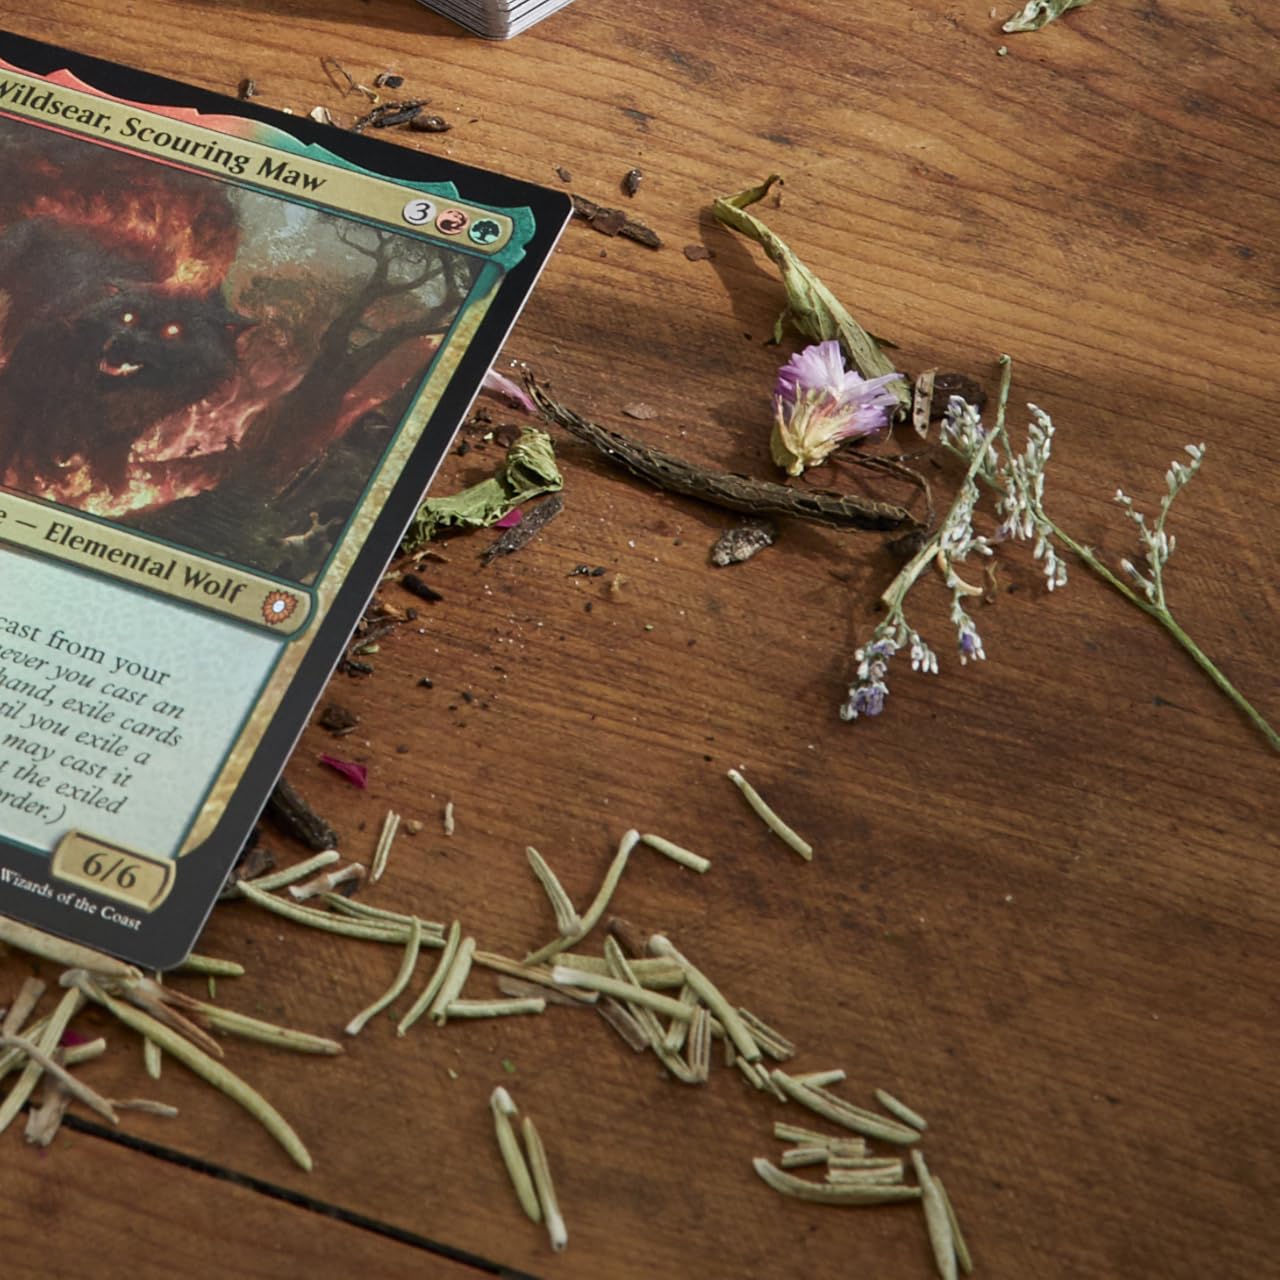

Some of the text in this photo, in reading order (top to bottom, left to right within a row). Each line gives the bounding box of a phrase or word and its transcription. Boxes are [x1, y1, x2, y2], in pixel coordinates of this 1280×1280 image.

[118, 116, 251, 175] Scouring
[255, 155, 328, 192] Maw
[42, 520, 178, 581] Elemental
[182, 565, 248, 604] Wolf
[44, 629, 106, 665] from
[107, 655, 172, 686] your
[44, 664, 96, 689] you
[99, 682, 149, 707] cast
[151, 700, 185, 720] an
[18, 712, 71, 738] you
[73, 730, 129, 758] exile
[132, 751, 152, 766] a
[60, 697, 116, 724] exile
[118, 717, 183, 747] cards
[0, 732, 57, 762] may
[58, 754, 109, 780] cast
[110, 766, 133, 788] it
[11, 763, 51, 789] the
[54, 782, 129, 815] exiled
[0, 866, 54, 899] Wizards
[55, 892, 76, 906] of
[73, 896, 98, 915] the
[99, 905, 142, 932] Coast
[81, 852, 140, 890] 6/6
